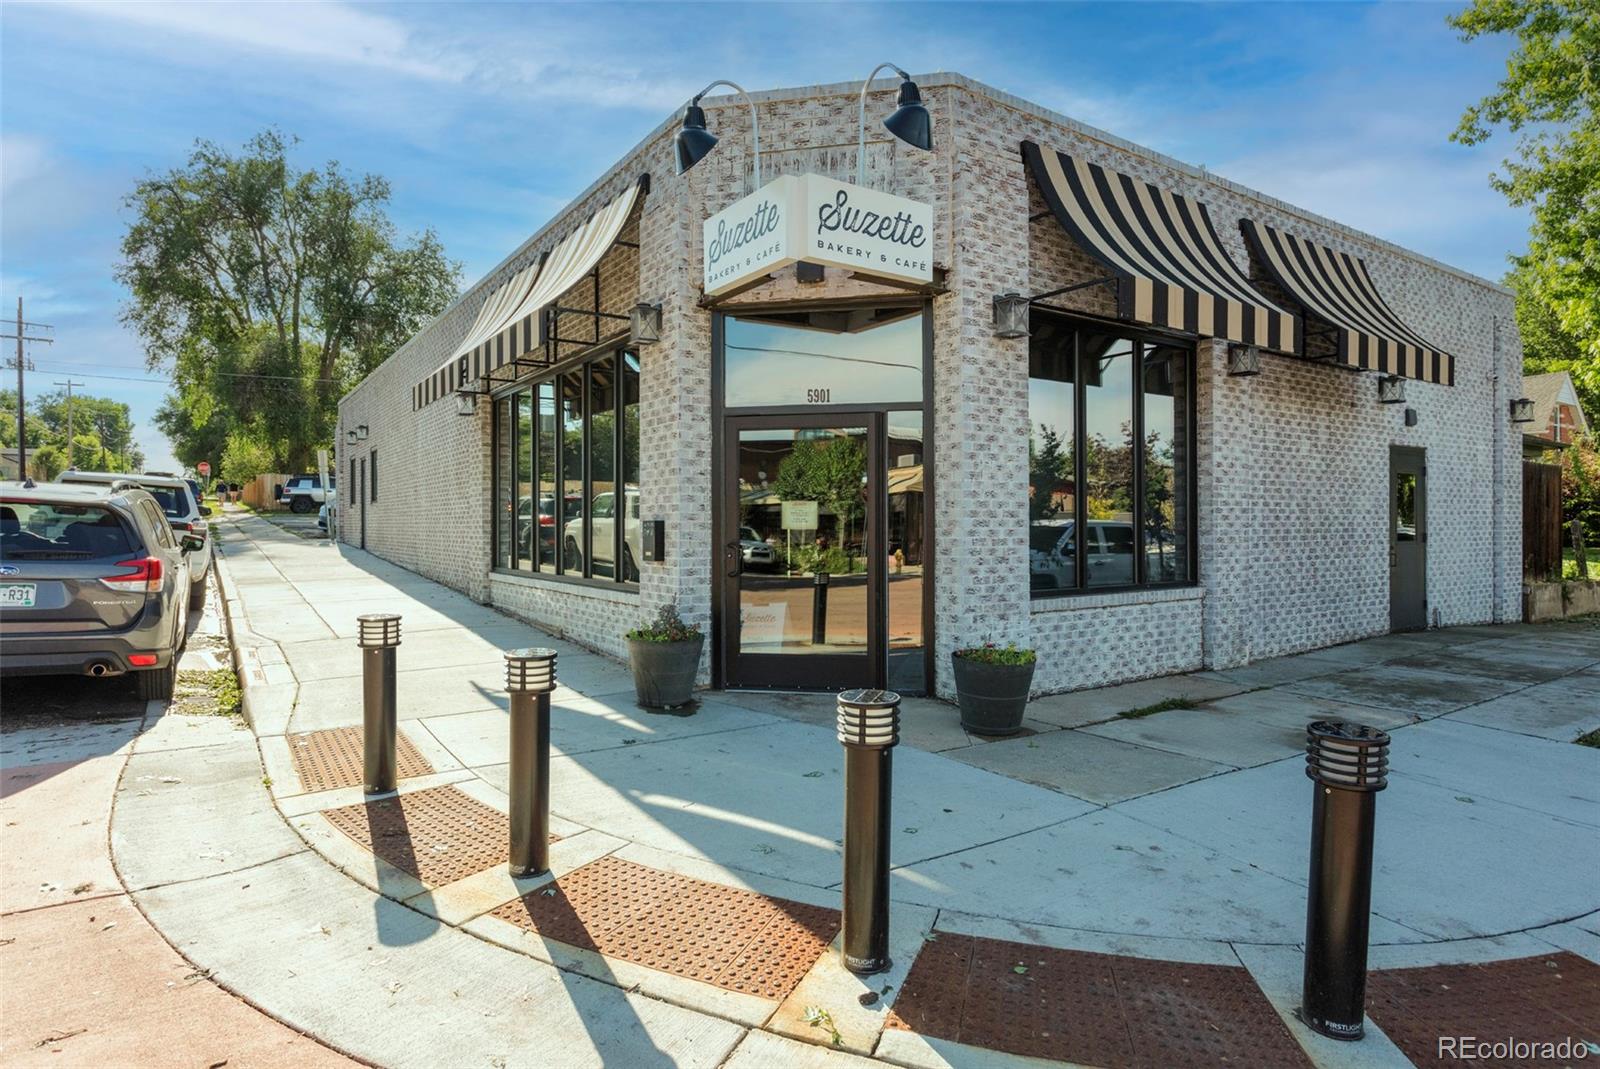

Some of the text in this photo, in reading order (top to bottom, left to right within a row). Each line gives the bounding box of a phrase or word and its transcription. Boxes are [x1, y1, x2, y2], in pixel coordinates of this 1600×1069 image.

[708, 200, 780, 272] Suzette
[818, 189, 927, 248] Suzette
[708, 241, 781, 283] BAKERY & CAFÉ
[817, 239, 927, 272] BAKERY & CAFÉ
[807, 388, 831, 403] 5901
